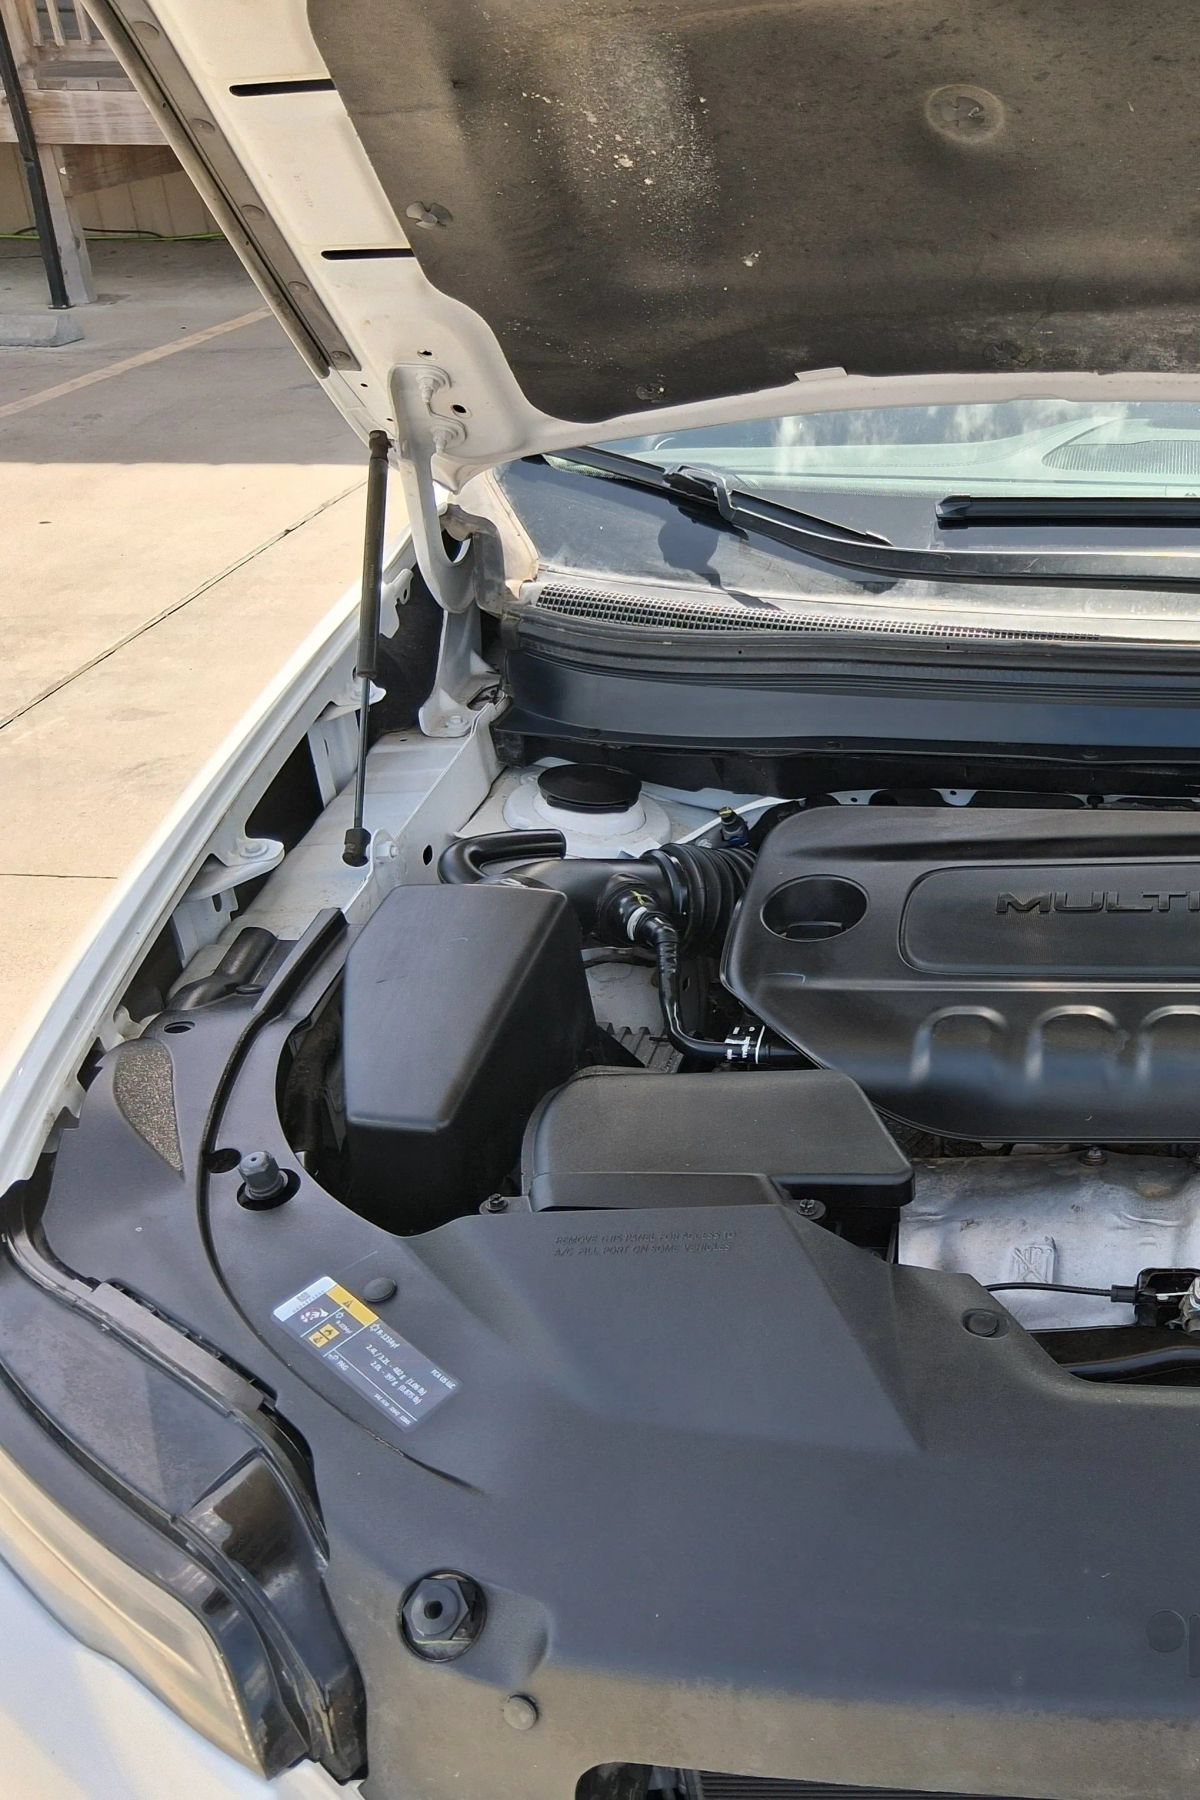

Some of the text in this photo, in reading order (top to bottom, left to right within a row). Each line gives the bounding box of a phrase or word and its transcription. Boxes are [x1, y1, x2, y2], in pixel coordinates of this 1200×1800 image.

[682, 1231, 721, 1240] ACCESS
[603, 1246, 629, 1255] PORT
[632, 1245, 649, 1254] ON
[651, 1244, 680, 1253] SOME
